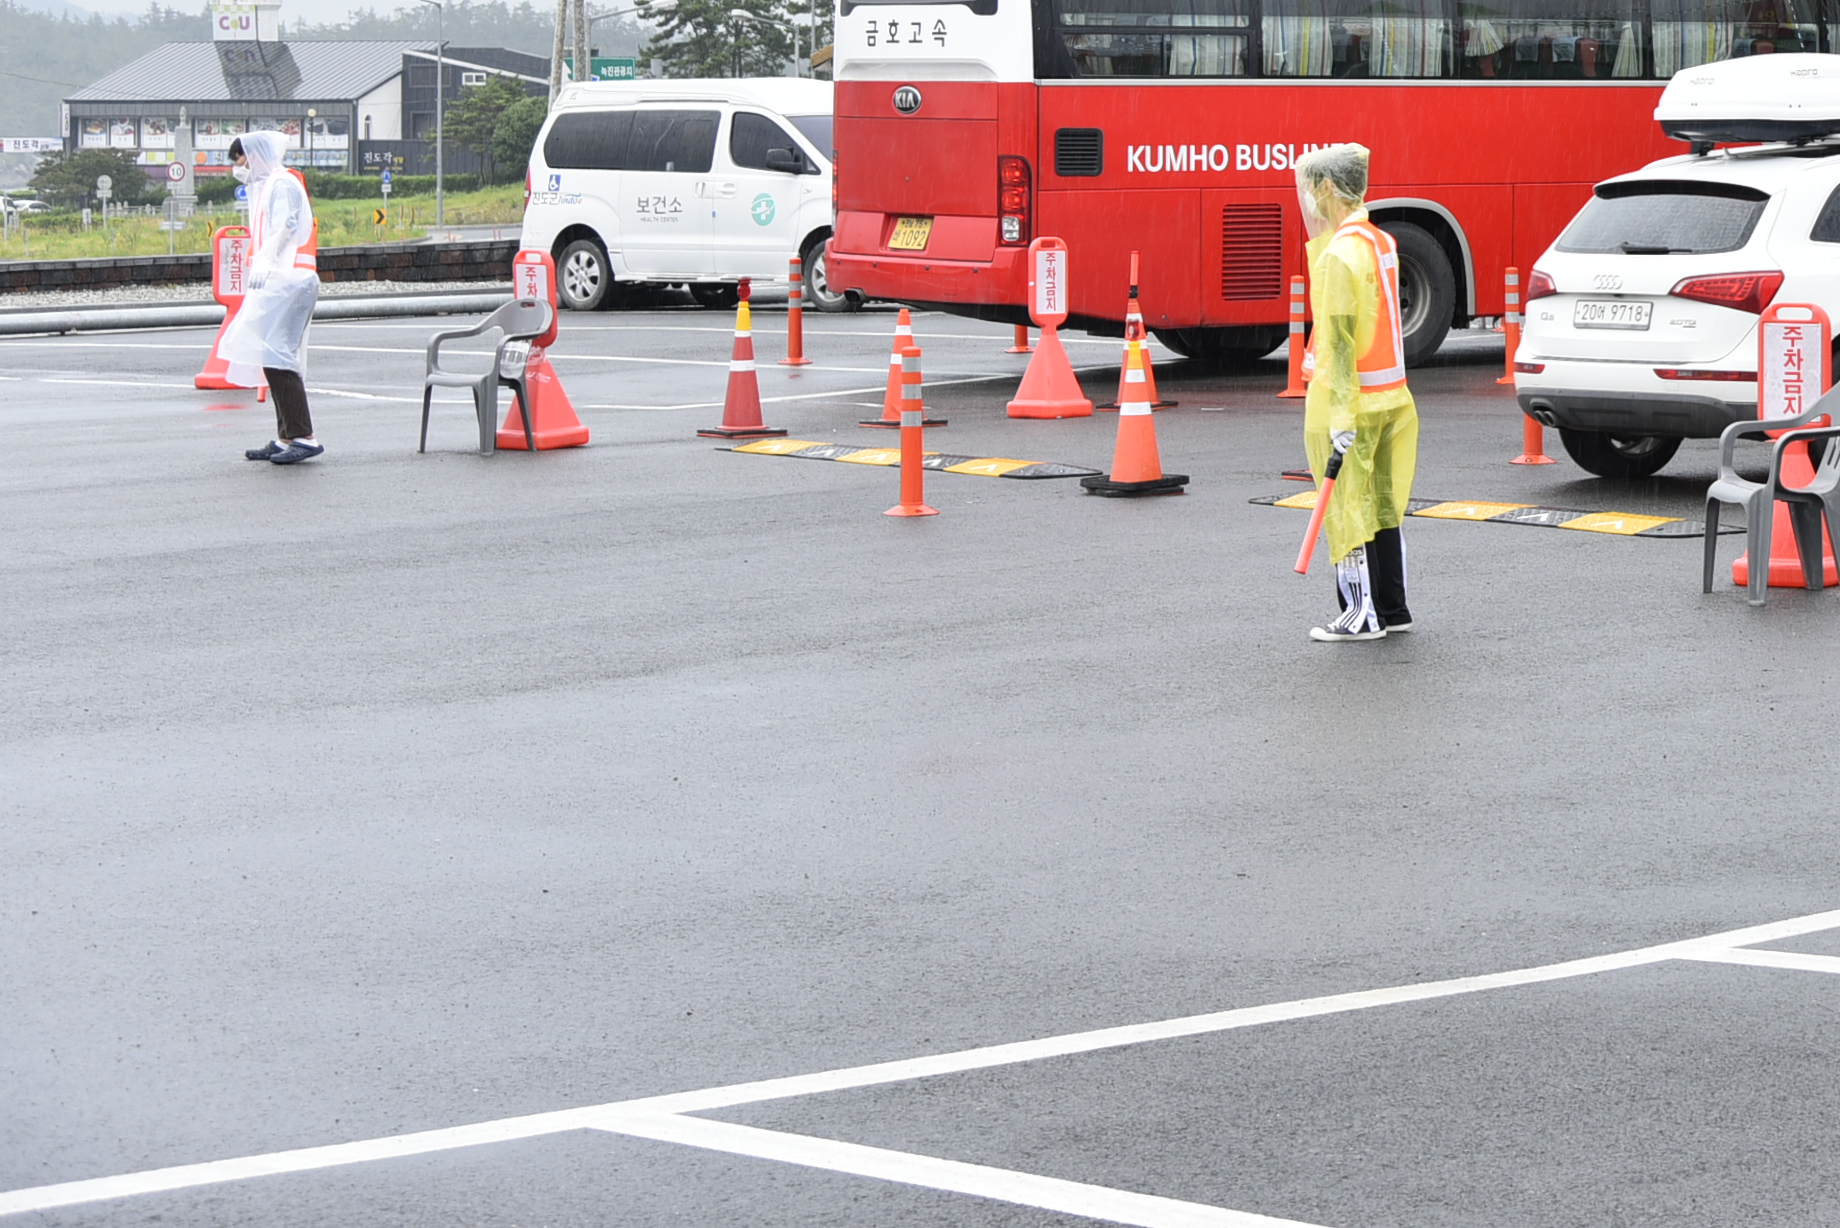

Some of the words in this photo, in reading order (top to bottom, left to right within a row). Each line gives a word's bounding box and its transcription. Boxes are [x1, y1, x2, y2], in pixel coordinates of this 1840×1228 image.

[218, 16, 251, 31] CU
[865, 18, 948, 47] 금호고속
[895, 91, 916, 108] KIA
[363, 151, 393, 164] 진도각
[1126, 143, 1230, 172] KUMHO
[171, 166, 182, 178] 10
[532, 191, 558, 206] 진도군
[635, 195, 683, 215] 보건소
[900, 230, 927, 247] 1092
[230, 239, 244, 294] 주차금지
[525, 266, 539, 299] 주차
[1045, 252, 1058, 312] 주차금지
[1581, 303, 1605, 321] 20어
[1610, 304, 1644, 322] 9718
[1782, 325, 1804, 416] 주차금지
